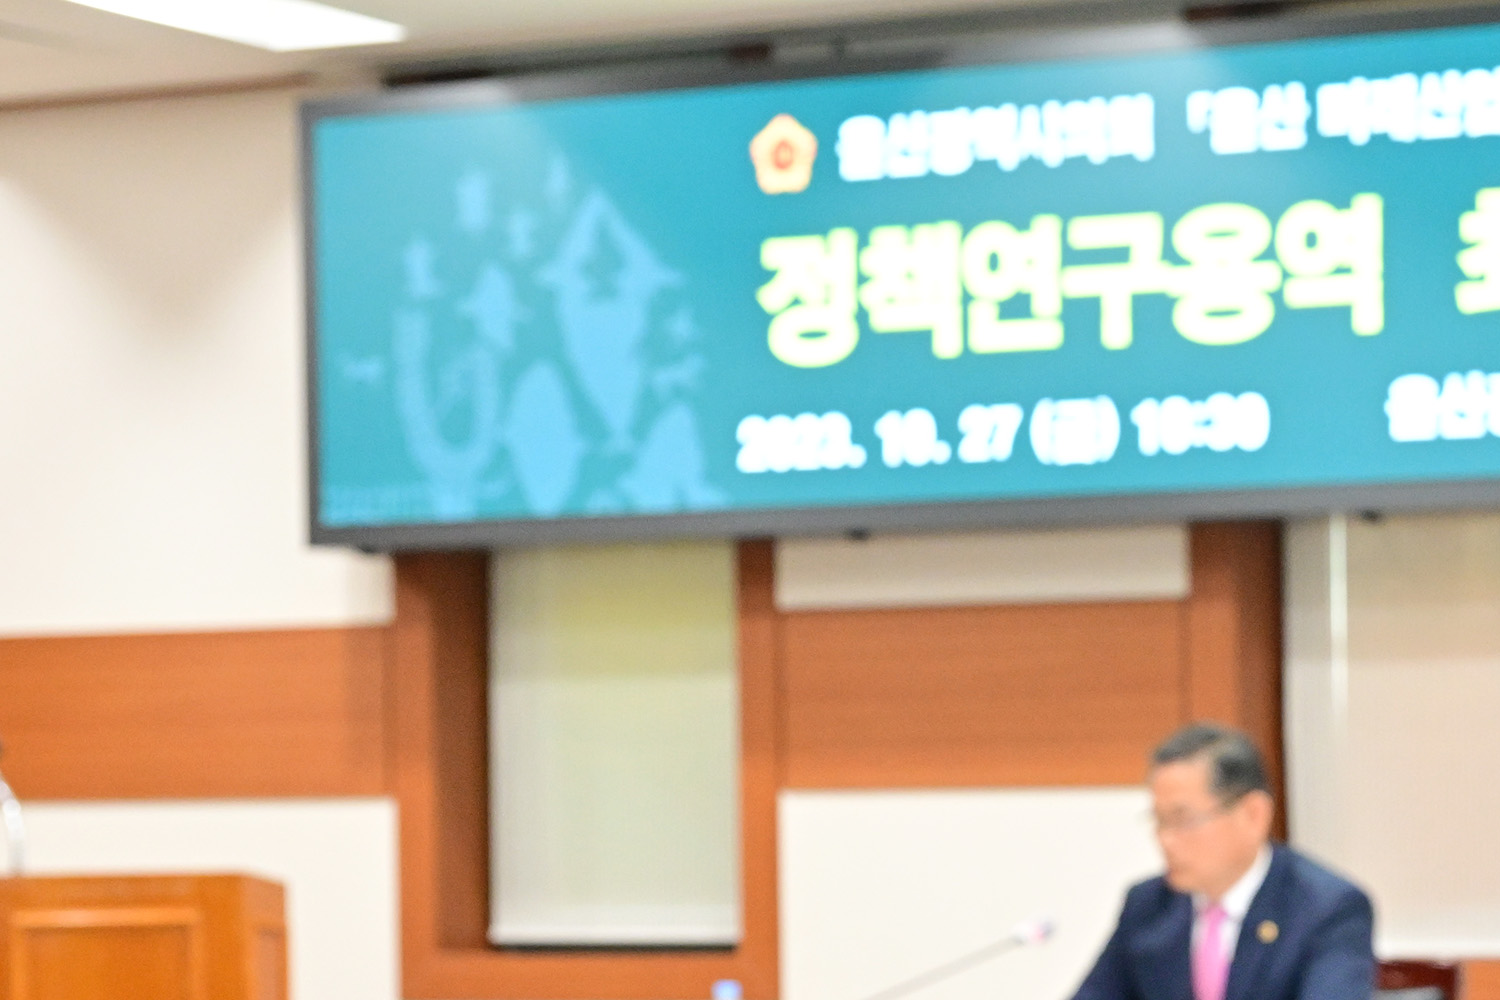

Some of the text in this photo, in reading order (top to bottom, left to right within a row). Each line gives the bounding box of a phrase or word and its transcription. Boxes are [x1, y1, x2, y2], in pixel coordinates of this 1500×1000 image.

[839, 94, 1154, 180] 울산광역시의회
[759, 204, 1383, 366] 정책연구용역
[738, 413, 865, 472] 2023.
[876, 410, 950, 465] 10.
